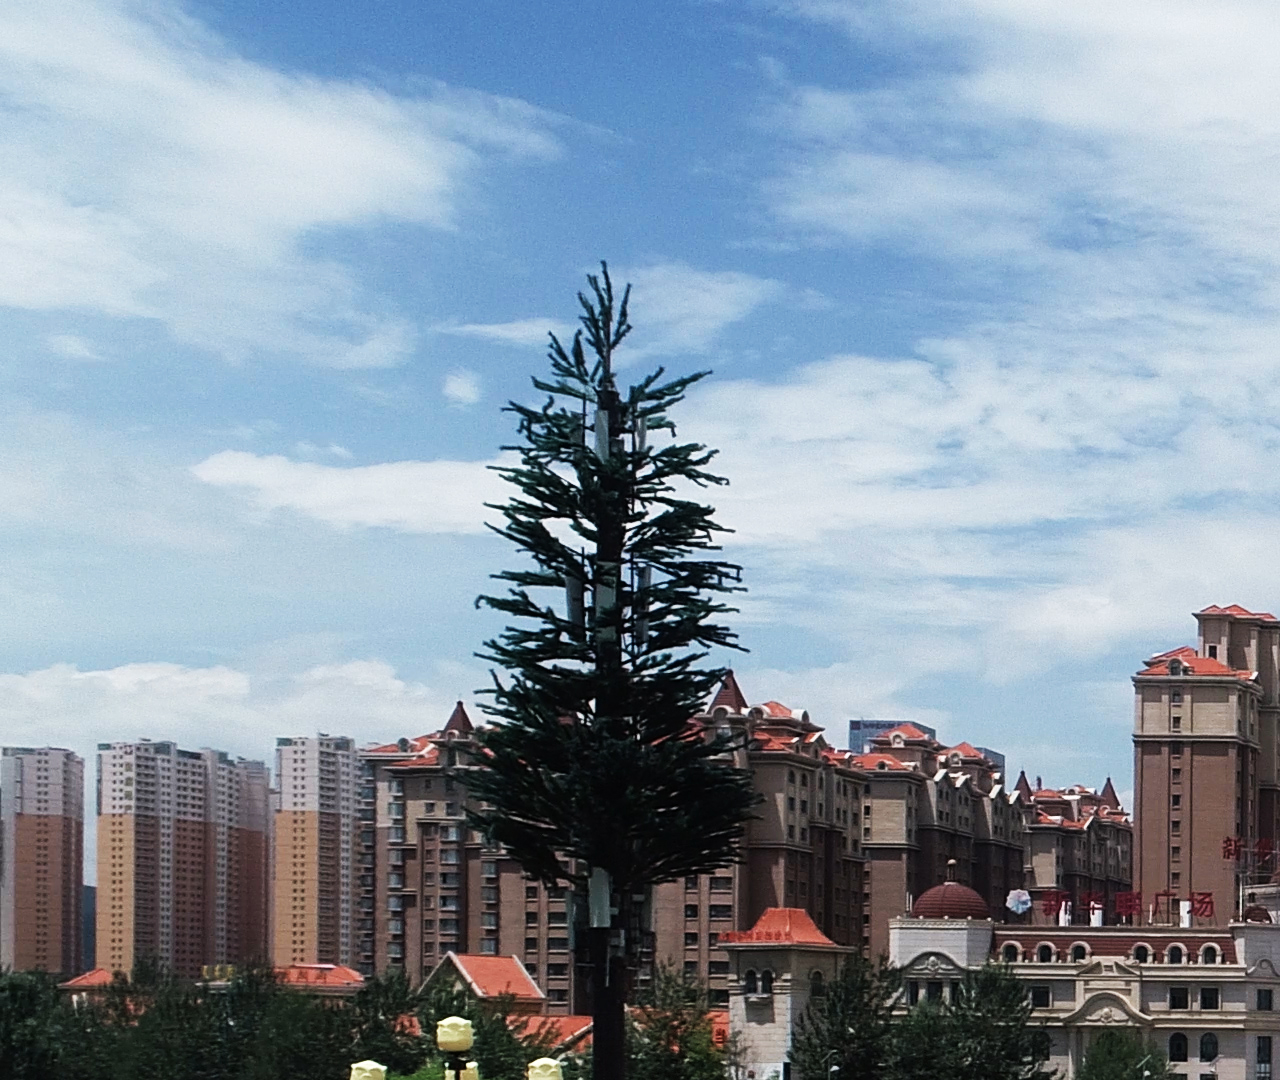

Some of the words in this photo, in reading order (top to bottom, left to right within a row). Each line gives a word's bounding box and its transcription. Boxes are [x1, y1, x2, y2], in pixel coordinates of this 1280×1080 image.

[1042, 889, 1215, 917] 新华联广场
